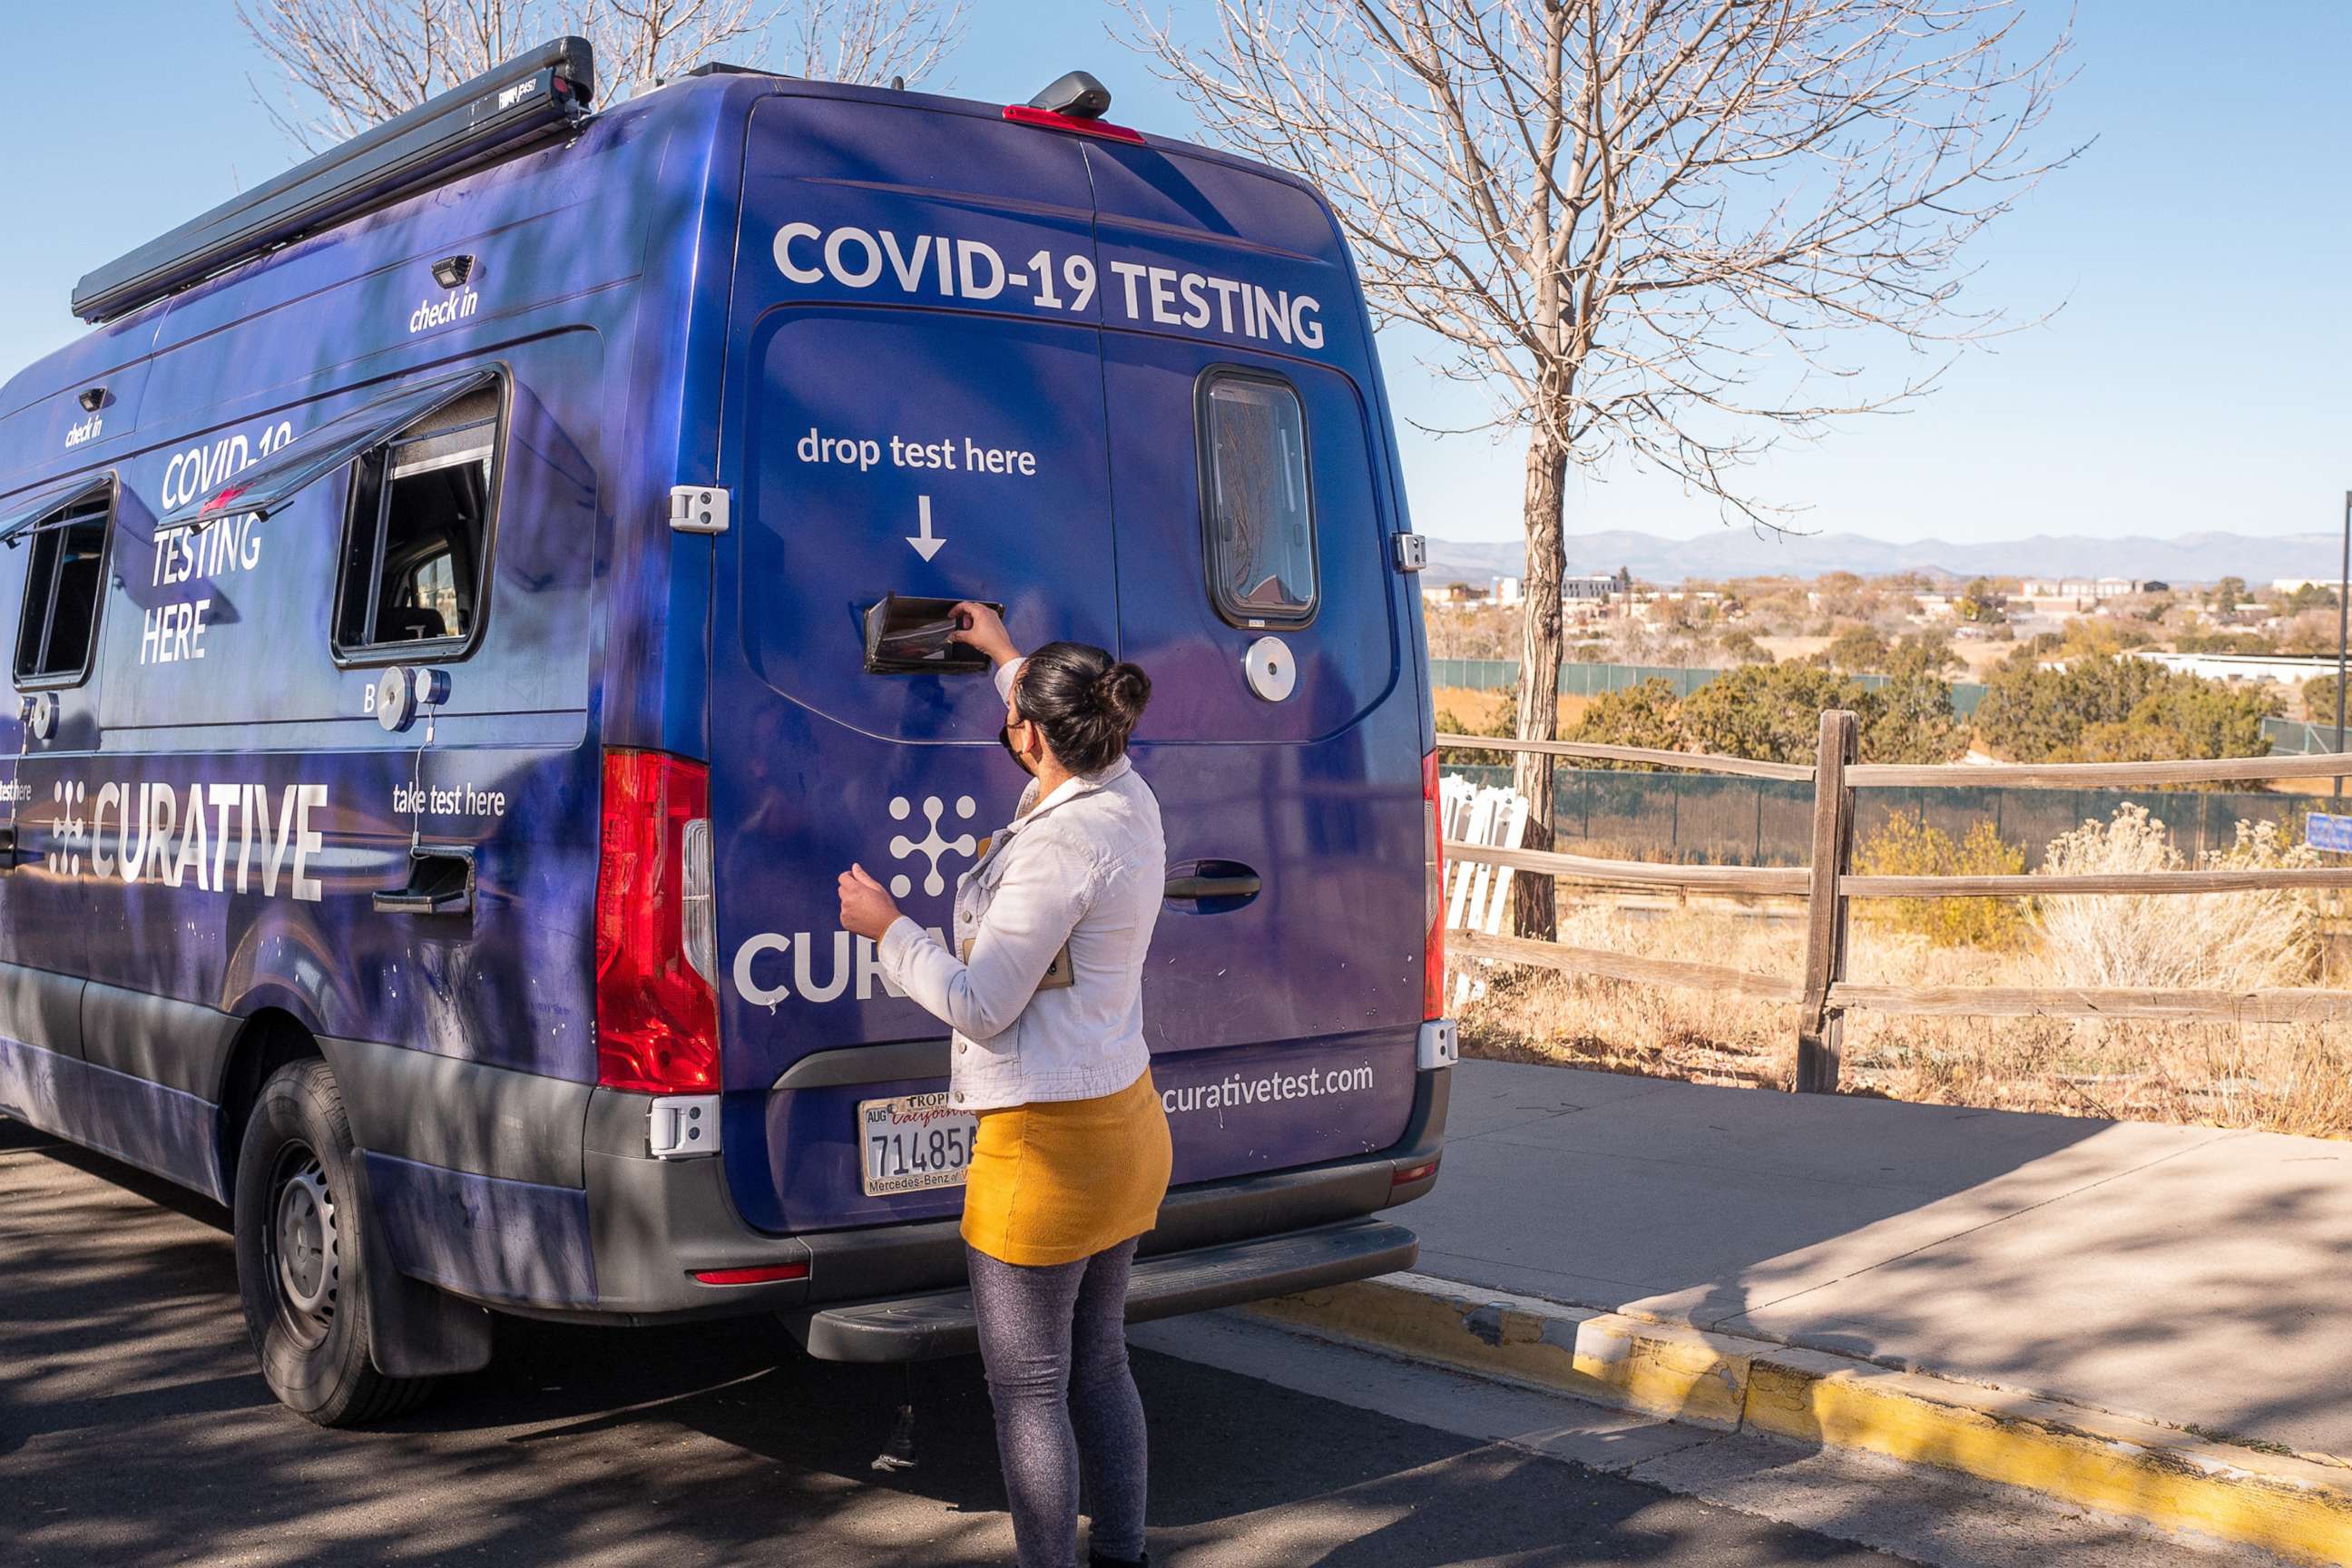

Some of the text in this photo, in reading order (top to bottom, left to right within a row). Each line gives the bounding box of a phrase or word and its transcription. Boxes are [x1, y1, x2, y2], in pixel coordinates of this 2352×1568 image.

[772, 221, 1325, 348] COVID-19 TESTING
[409, 286, 478, 333] check in
[65, 415, 103, 448] check in
[797, 427, 1036, 476] drop test here
[152, 513, 261, 586] TESTING
[141, 599, 211, 665] HERE
[364, 683, 375, 713] B
[393, 781, 505, 817] take test here
[92, 782, 328, 901] CURATIVE
[907, 1093, 949, 1107] TROP
[1161, 1066, 1373, 1113] curativetest.com
[867, 1112, 887, 1122] AUG
[869, 1174, 949, 1192] Mercedes-Benz
